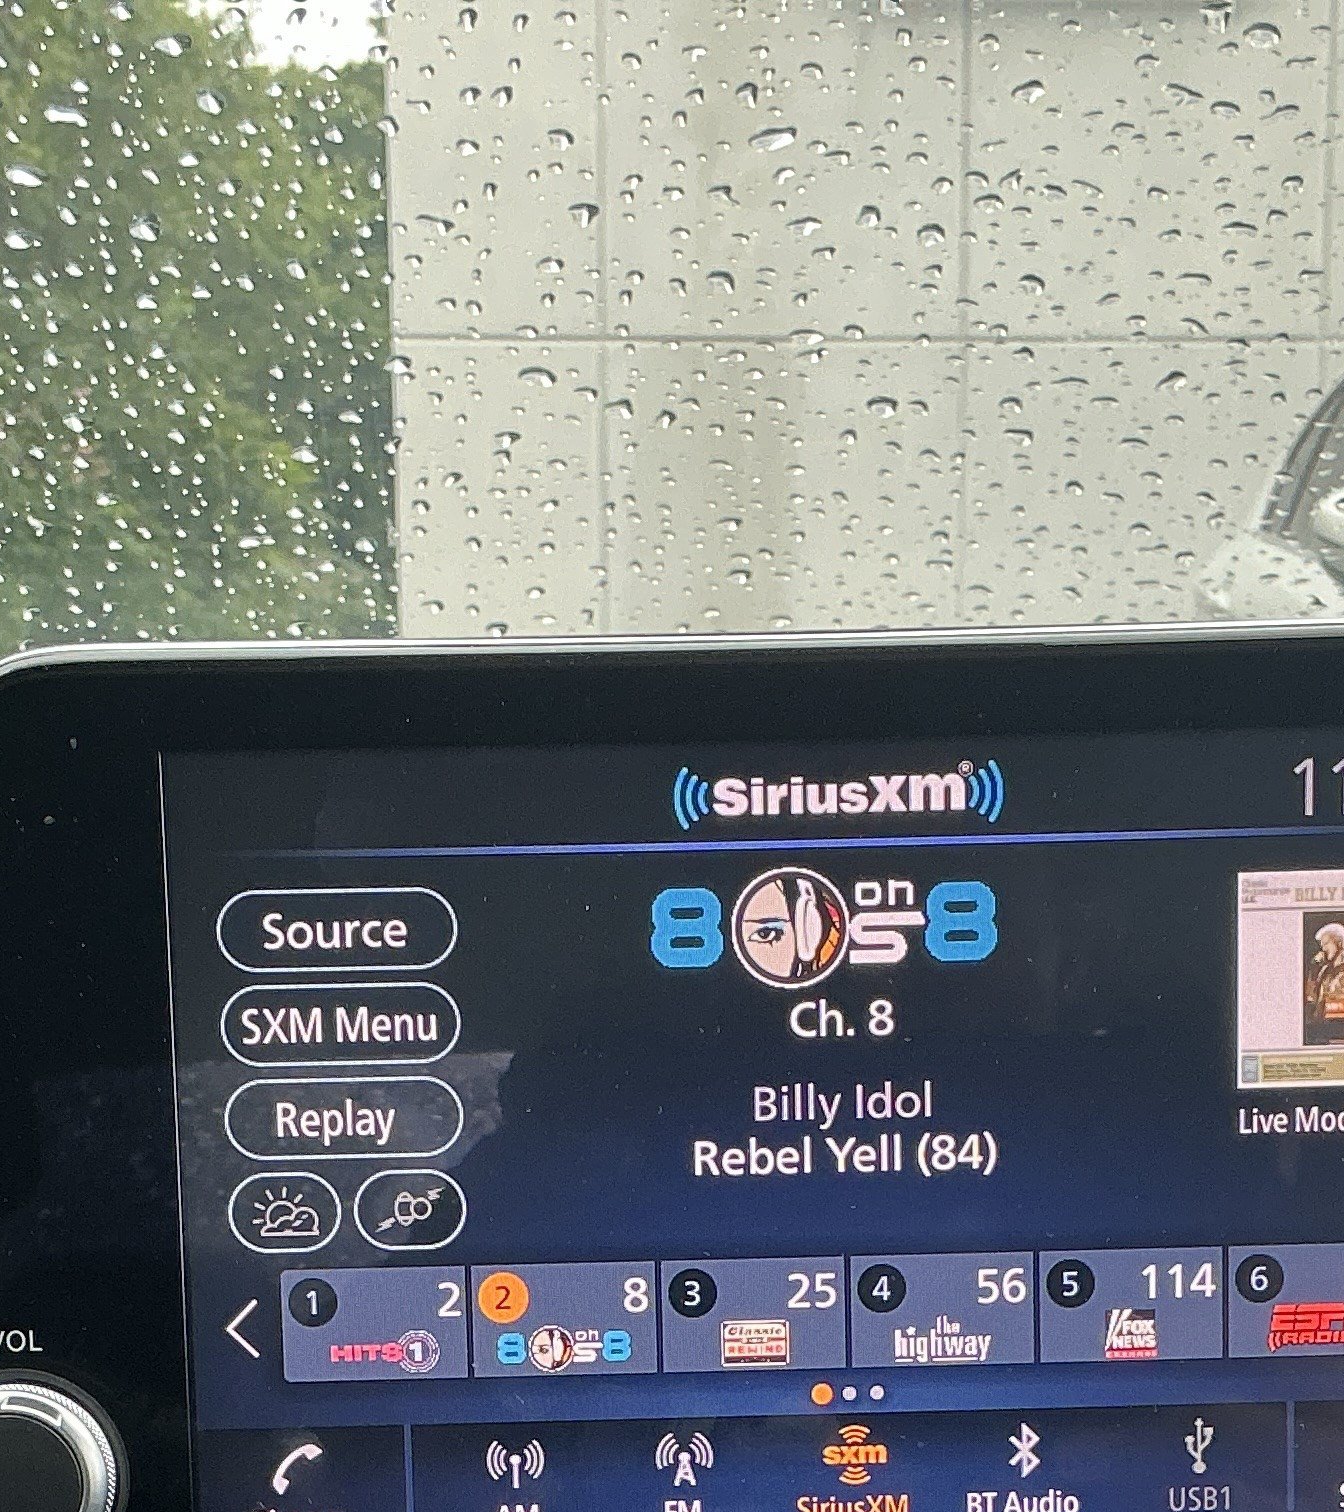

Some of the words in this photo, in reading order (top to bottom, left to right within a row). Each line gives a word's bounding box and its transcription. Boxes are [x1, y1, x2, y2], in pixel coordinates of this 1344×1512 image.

[262, 912, 408, 950] Source
[924, 880, 998, 963] 8
[240, 1007, 323, 1045] SXM
[335, 1006, 438, 1043] Menu
[789, 999, 855, 1038] Ch.
[867, 999, 895, 1037] 8
[753, 1082, 841, 1130] Billy
[855, 1079, 934, 1119] Idol
[1238, 1106, 1288, 1134] Live
[276, 1099, 395, 1147] Replay
[693, 1136, 813, 1176] Rebel
[825, 1133, 902, 1173] Yell
[917, 1130, 998, 1177] (84)
[622, 1276, 650, 1313] 8
[683, 1280, 702, 1306] 3
[787, 1272, 837, 1310] 25
[870, 1274, 892, 1301] 4
[976, 1266, 1027, 1303] 56
[1062, 1271, 1080, 1297] 5
[1141, 1263, 1217, 1300] 114
[1250, 1266, 1269, 1292] 6
[304, 1289, 319, 1316] 1
[437, 1282, 463, 1318] 2
[495, 1285, 512, 1311] 2
[936, 1314, 961, 1334] the
[1122, 1319, 1156, 1335] FOX
[894, 1326, 992, 1361] highway
[1112, 1334, 1157, 1350] NEWS
[821, 1444, 889, 1465] sxm
[1168, 1486, 1232, 1512] USB1
